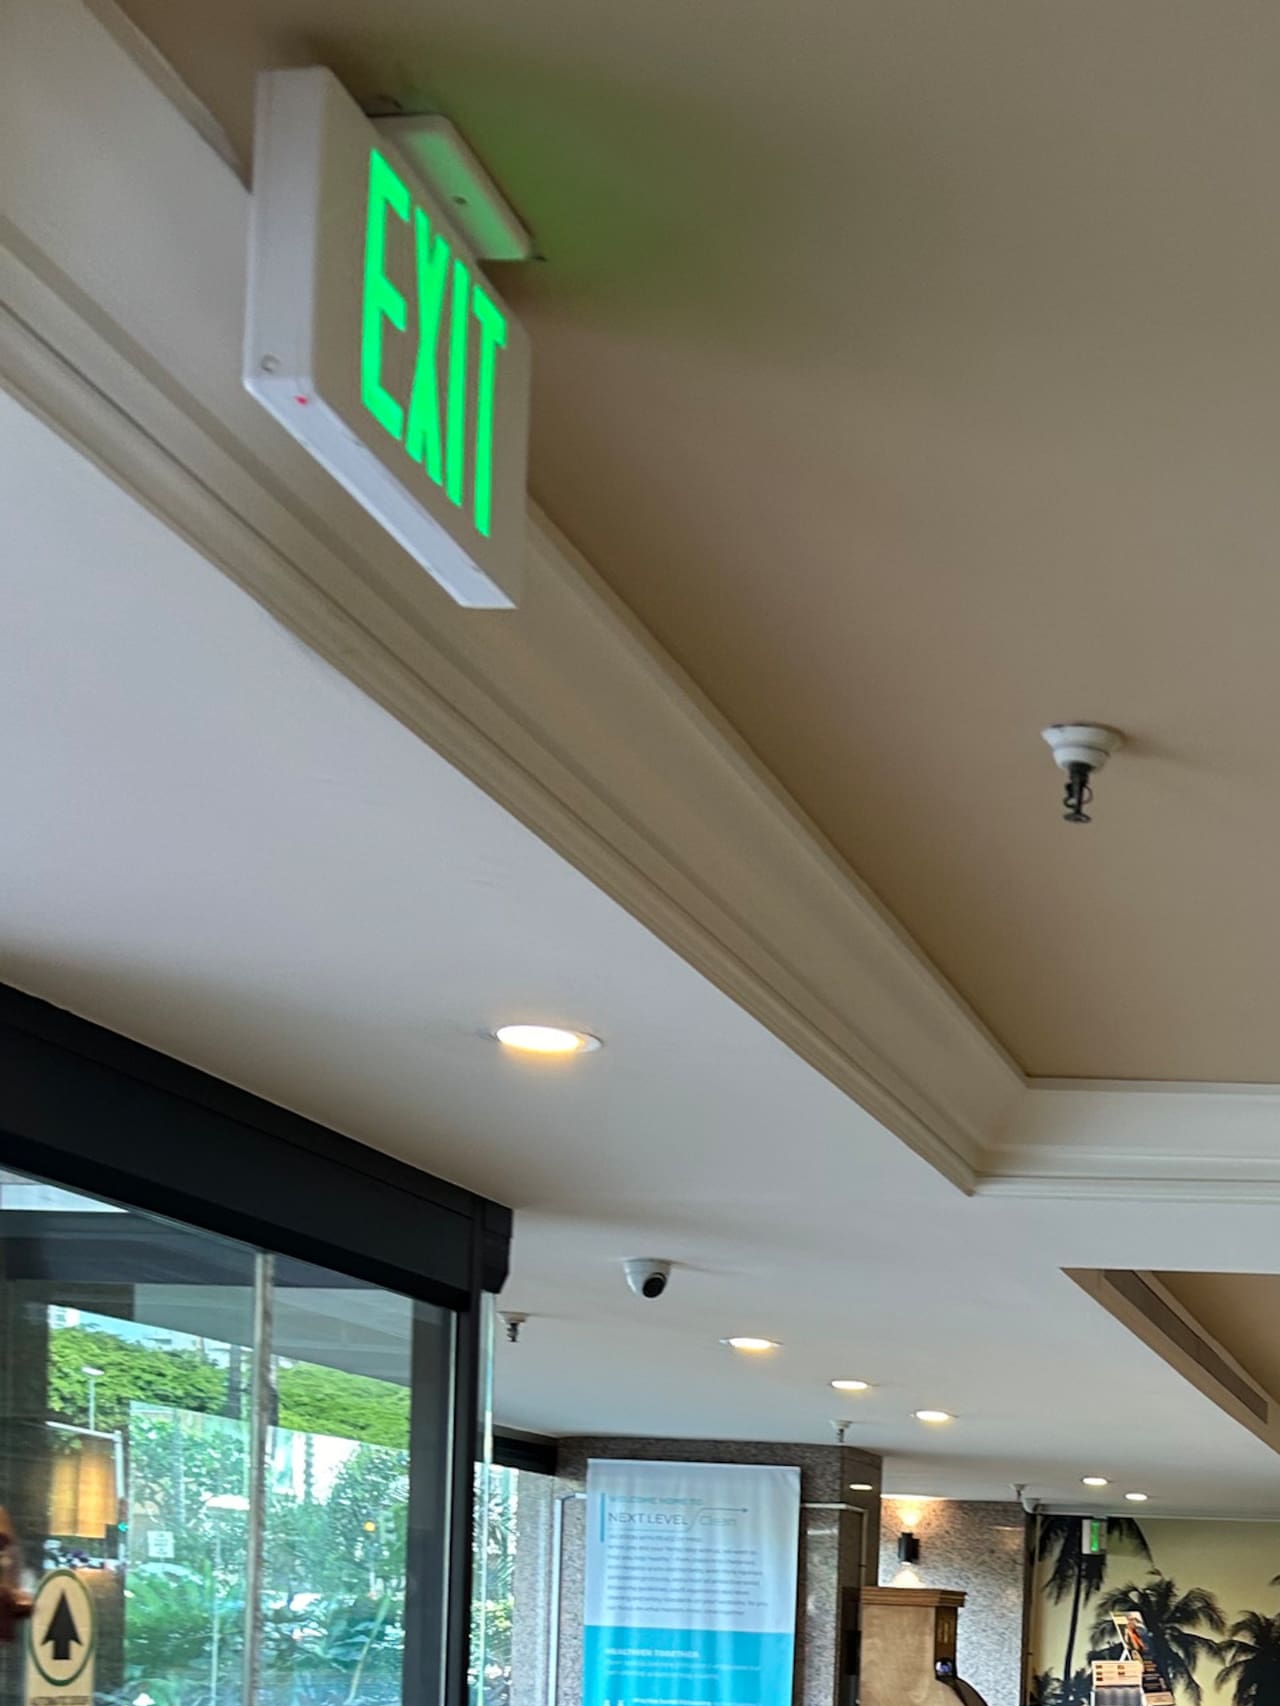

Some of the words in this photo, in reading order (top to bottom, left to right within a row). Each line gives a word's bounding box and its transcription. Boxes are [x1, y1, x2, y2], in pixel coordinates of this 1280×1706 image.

[360, 148, 507, 538] EXIT
[607, 1512, 644, 1524] NEXT
[647, 1514, 689, 1526] LEVEL
